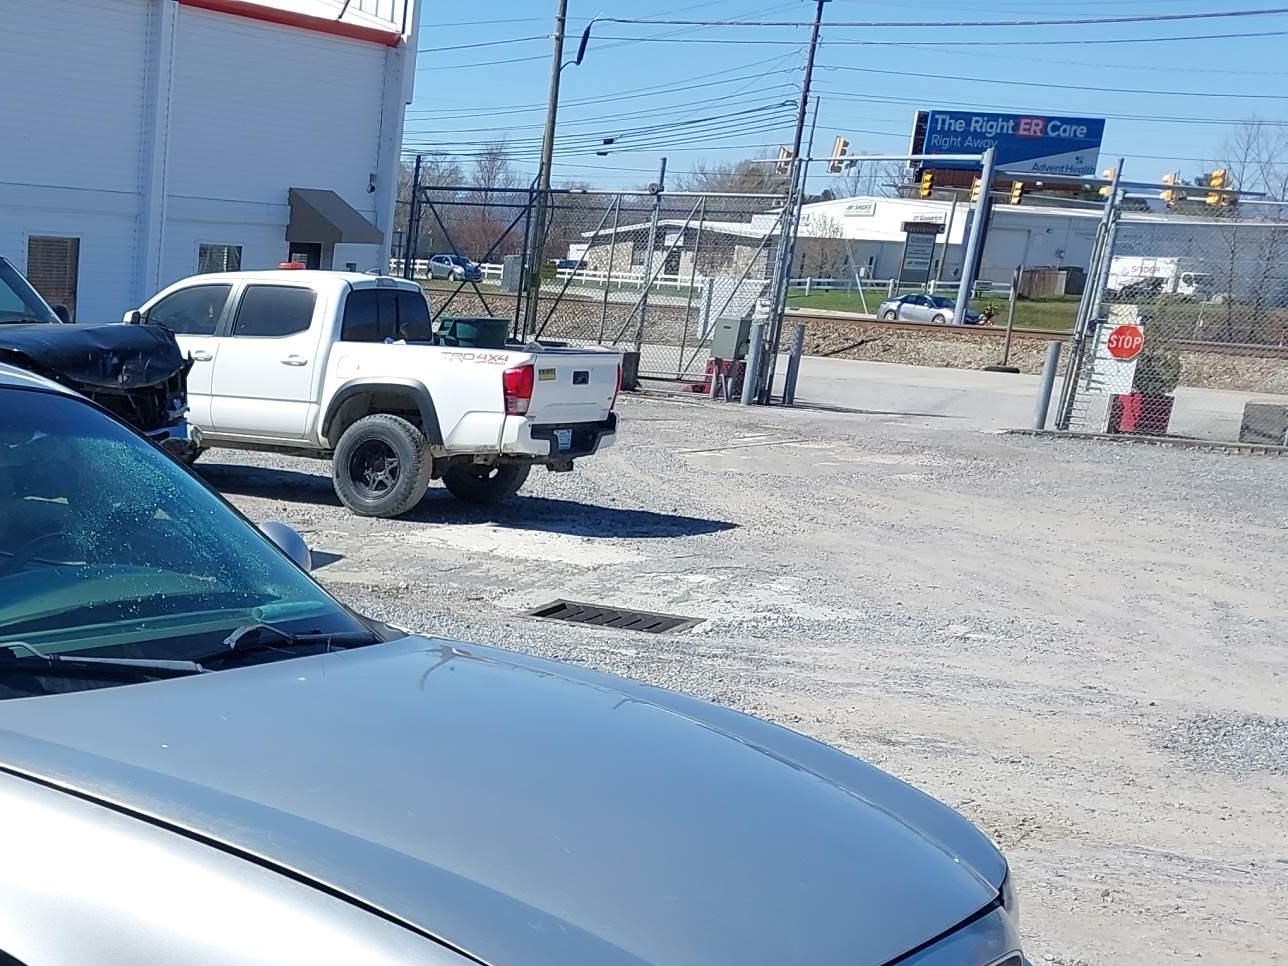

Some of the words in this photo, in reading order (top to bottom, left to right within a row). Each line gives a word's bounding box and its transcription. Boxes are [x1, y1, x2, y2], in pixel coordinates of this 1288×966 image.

[935, 114, 965, 132] The
[970, 116, 1015, 137] Right
[1018, 118, 1043, 136] ER
[1046, 120, 1087, 138] Care
[930, 134, 961, 149] Right
[965, 136, 998, 149] Away
[1109, 335, 1142, 349] STOP
